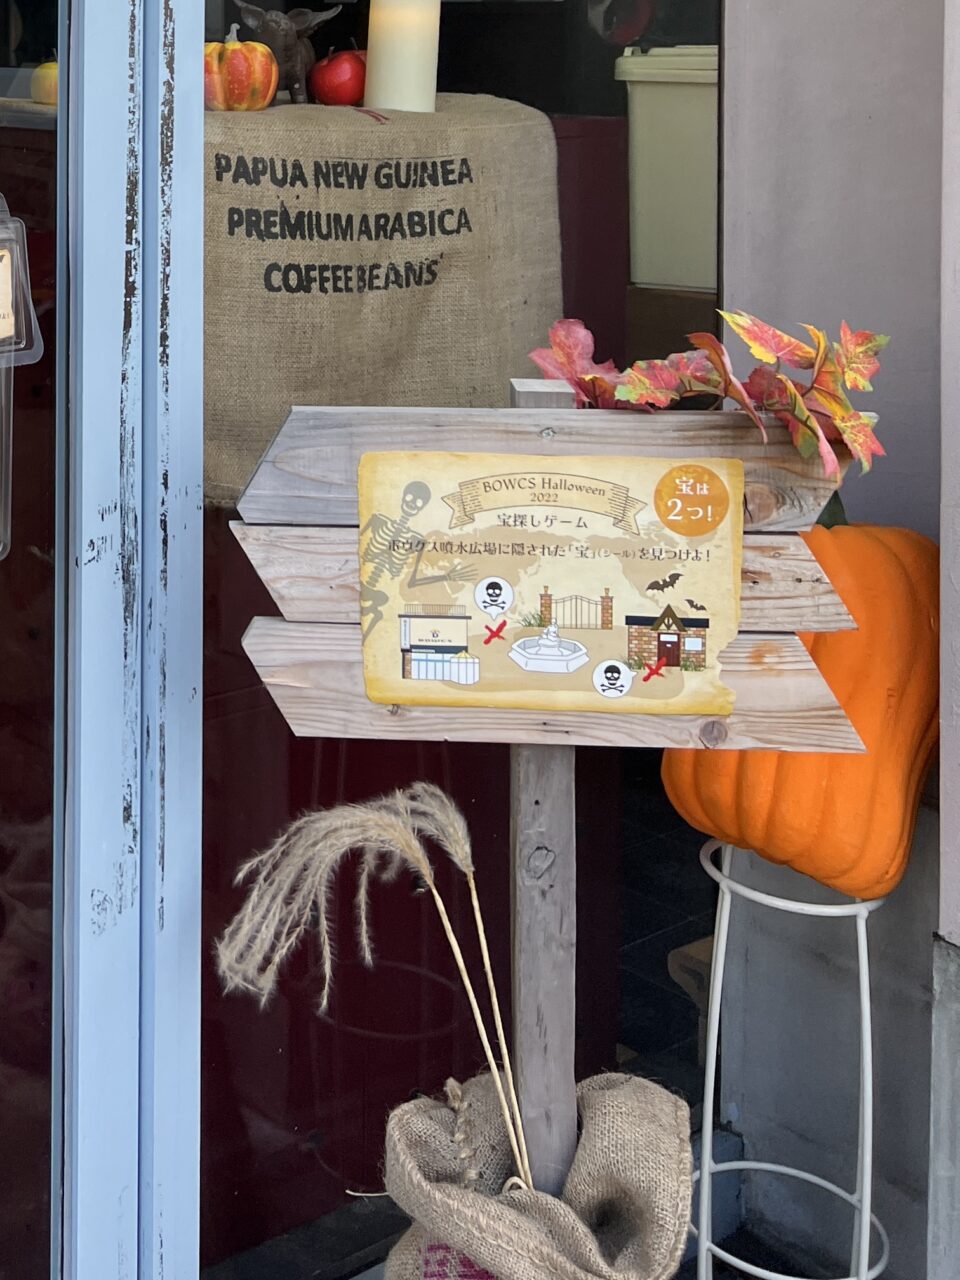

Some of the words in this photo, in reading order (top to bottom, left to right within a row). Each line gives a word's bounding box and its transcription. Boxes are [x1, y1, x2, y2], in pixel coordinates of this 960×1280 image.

[214, 152, 308, 189] PAPUA
[313, 159, 368, 190] NEW
[373, 157, 474, 190] GUINEA
[227, 203, 354, 242] PREMIUM
[357, 207, 473, 241] ARABICA
[263, 262, 353, 294] COFFEE
[356, 259, 441, 294] BEANS
[482, 478, 536, 493] BOWCS
[541, 477, 606, 497] Halloween
[675, 476, 709, 496] 宝は
[530, 493, 558, 503] 2022
[497, 513, 588, 529] 宝探しゲーム
[667, 498, 712, 522] 2つ！
